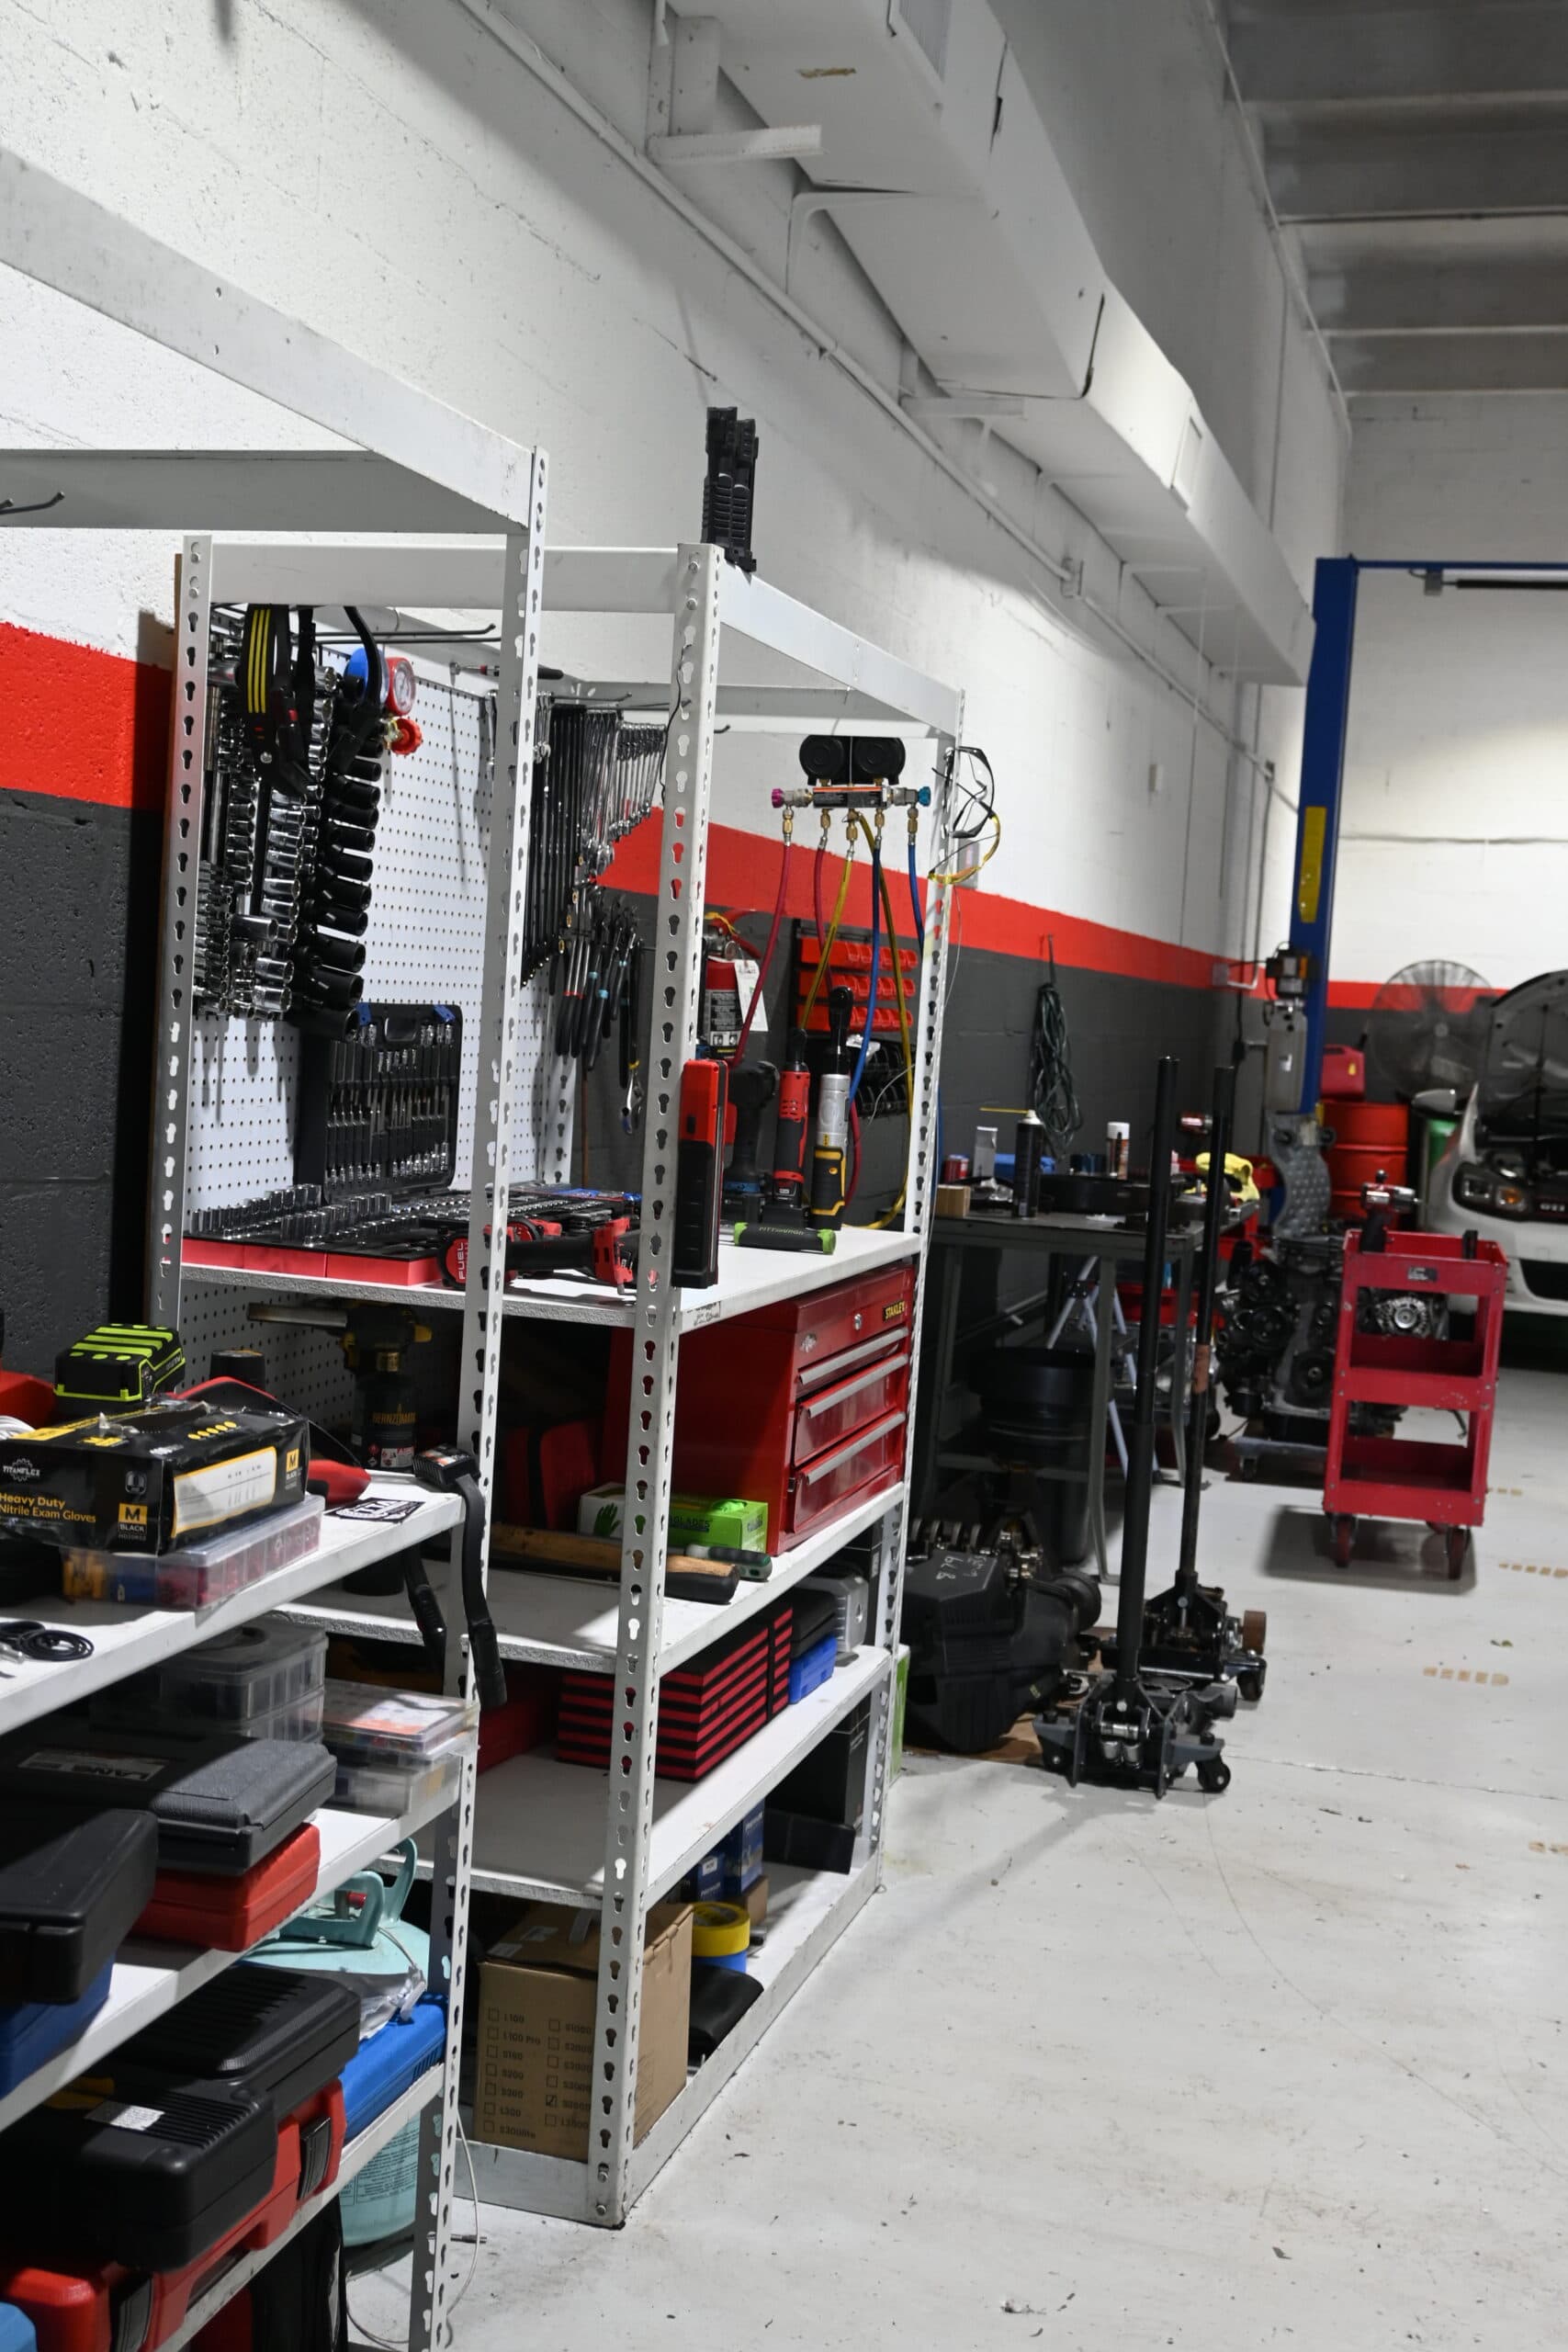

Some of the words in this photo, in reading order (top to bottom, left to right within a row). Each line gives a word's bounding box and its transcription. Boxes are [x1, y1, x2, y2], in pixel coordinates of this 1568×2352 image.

[457, 1241, 466, 1280] FUEL
[885, 1300, 906, 1320] STANLEY
[0, 1492, 35, 1507] Heavy
[38, 1496, 66, 1510] Duty
[0, 1504, 30, 1516] Nitrile
[33, 1507, 61, 1520] Exam
[62, 1510, 96, 1524] Gloves
